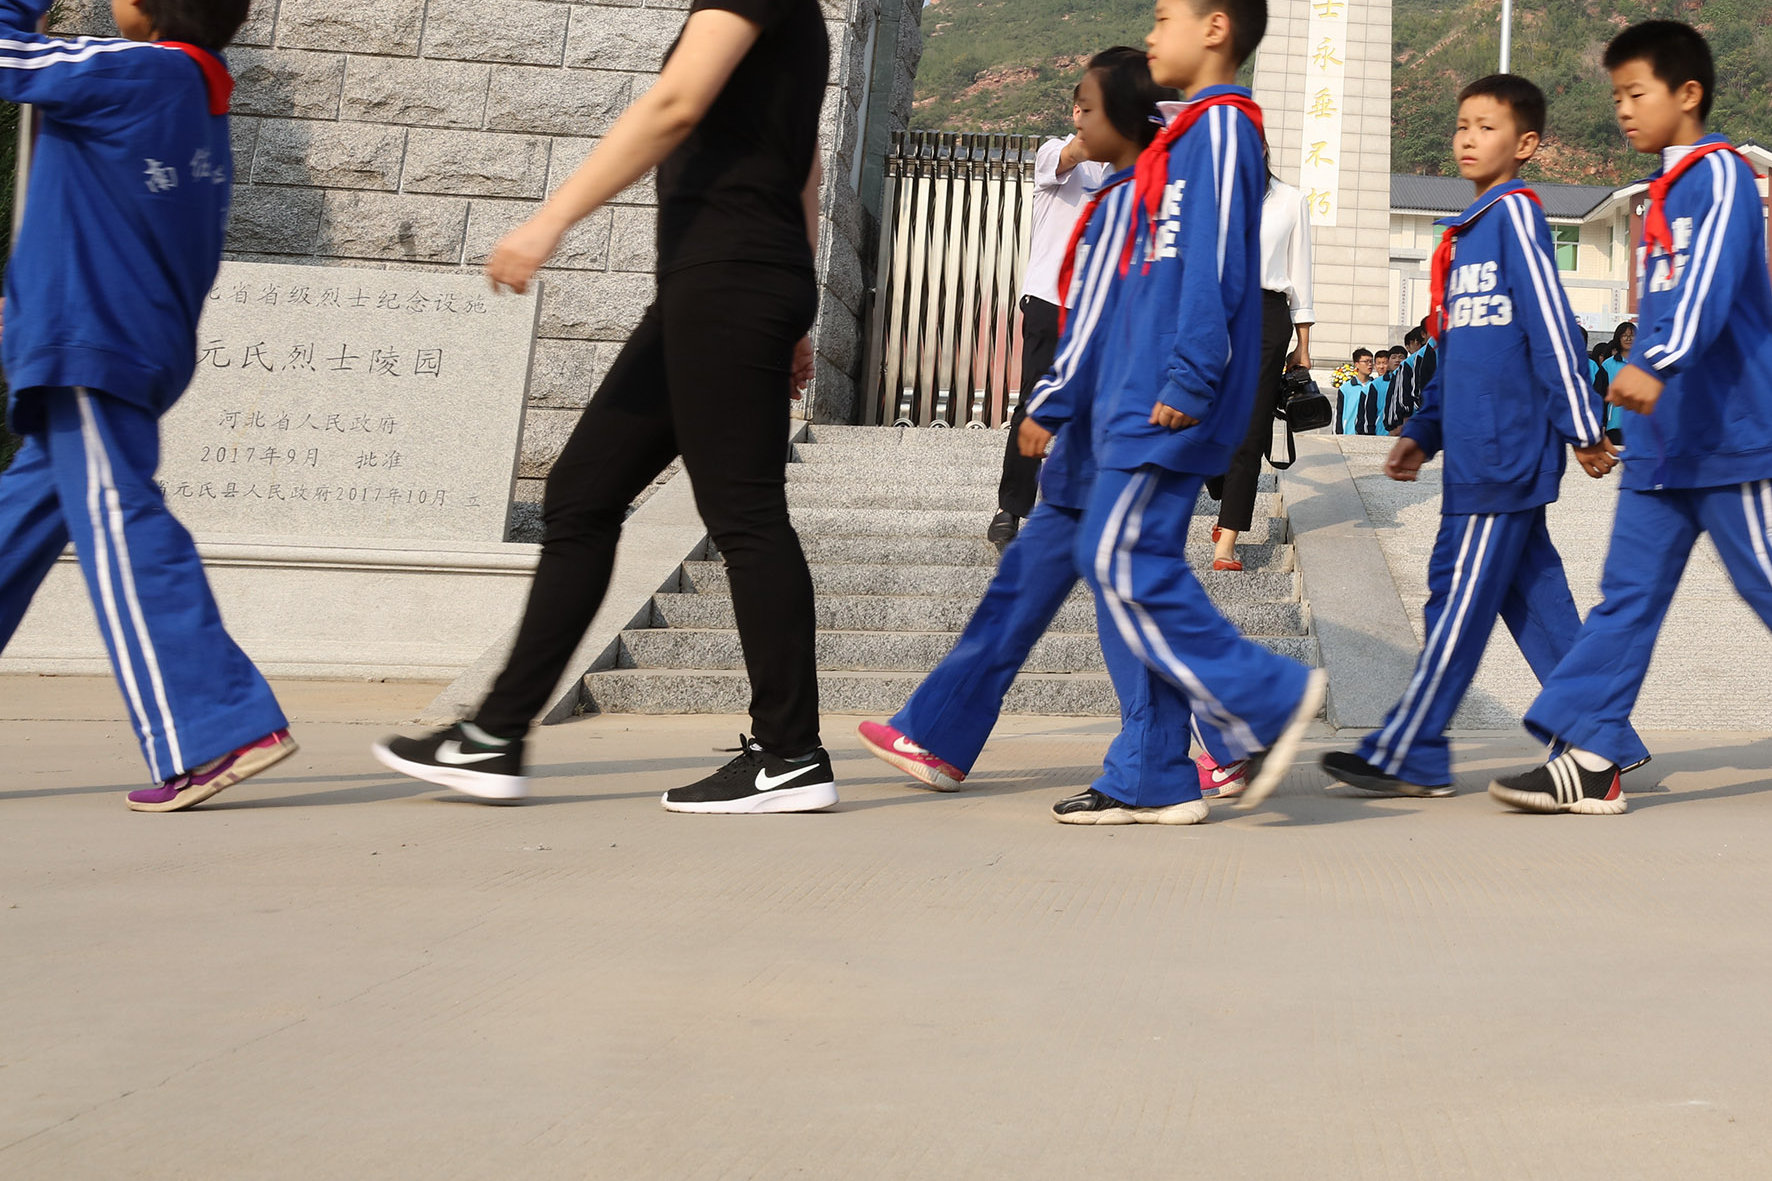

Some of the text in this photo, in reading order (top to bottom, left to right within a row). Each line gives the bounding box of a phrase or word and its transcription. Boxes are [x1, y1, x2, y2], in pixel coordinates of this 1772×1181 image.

[196, 339, 443, 379] 元氏烈士陵园
[218, 409, 399, 435] 河北省人民政府
[200, 445, 404, 470] 2017年9月 批准
